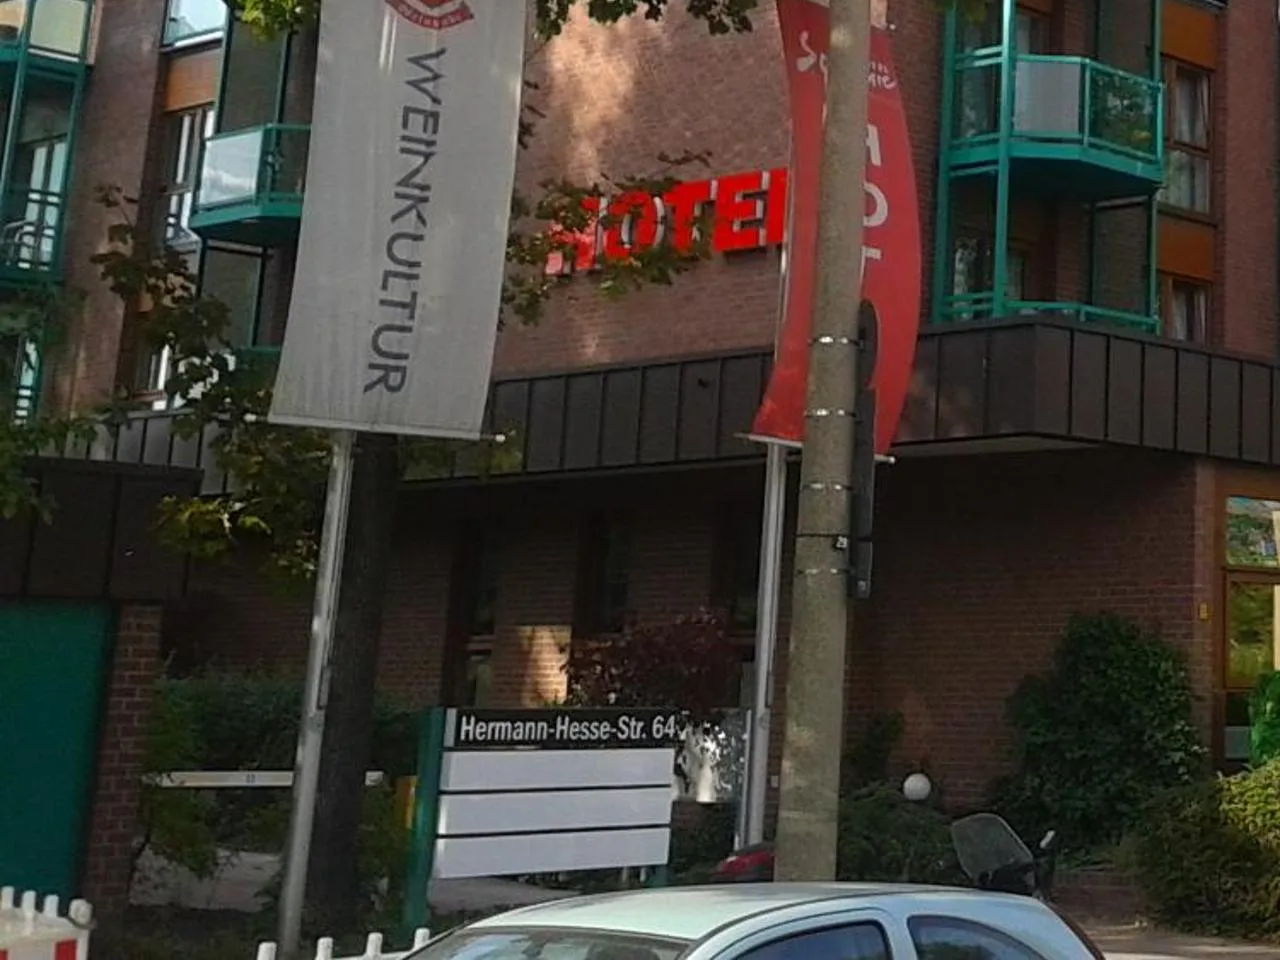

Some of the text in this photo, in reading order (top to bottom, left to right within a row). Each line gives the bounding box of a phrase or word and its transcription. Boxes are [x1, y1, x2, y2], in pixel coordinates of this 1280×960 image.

[363, 47, 448, 394] WEINKULTUR
[460, 714, 677, 741] Hermann-Hesse-Str. 64
